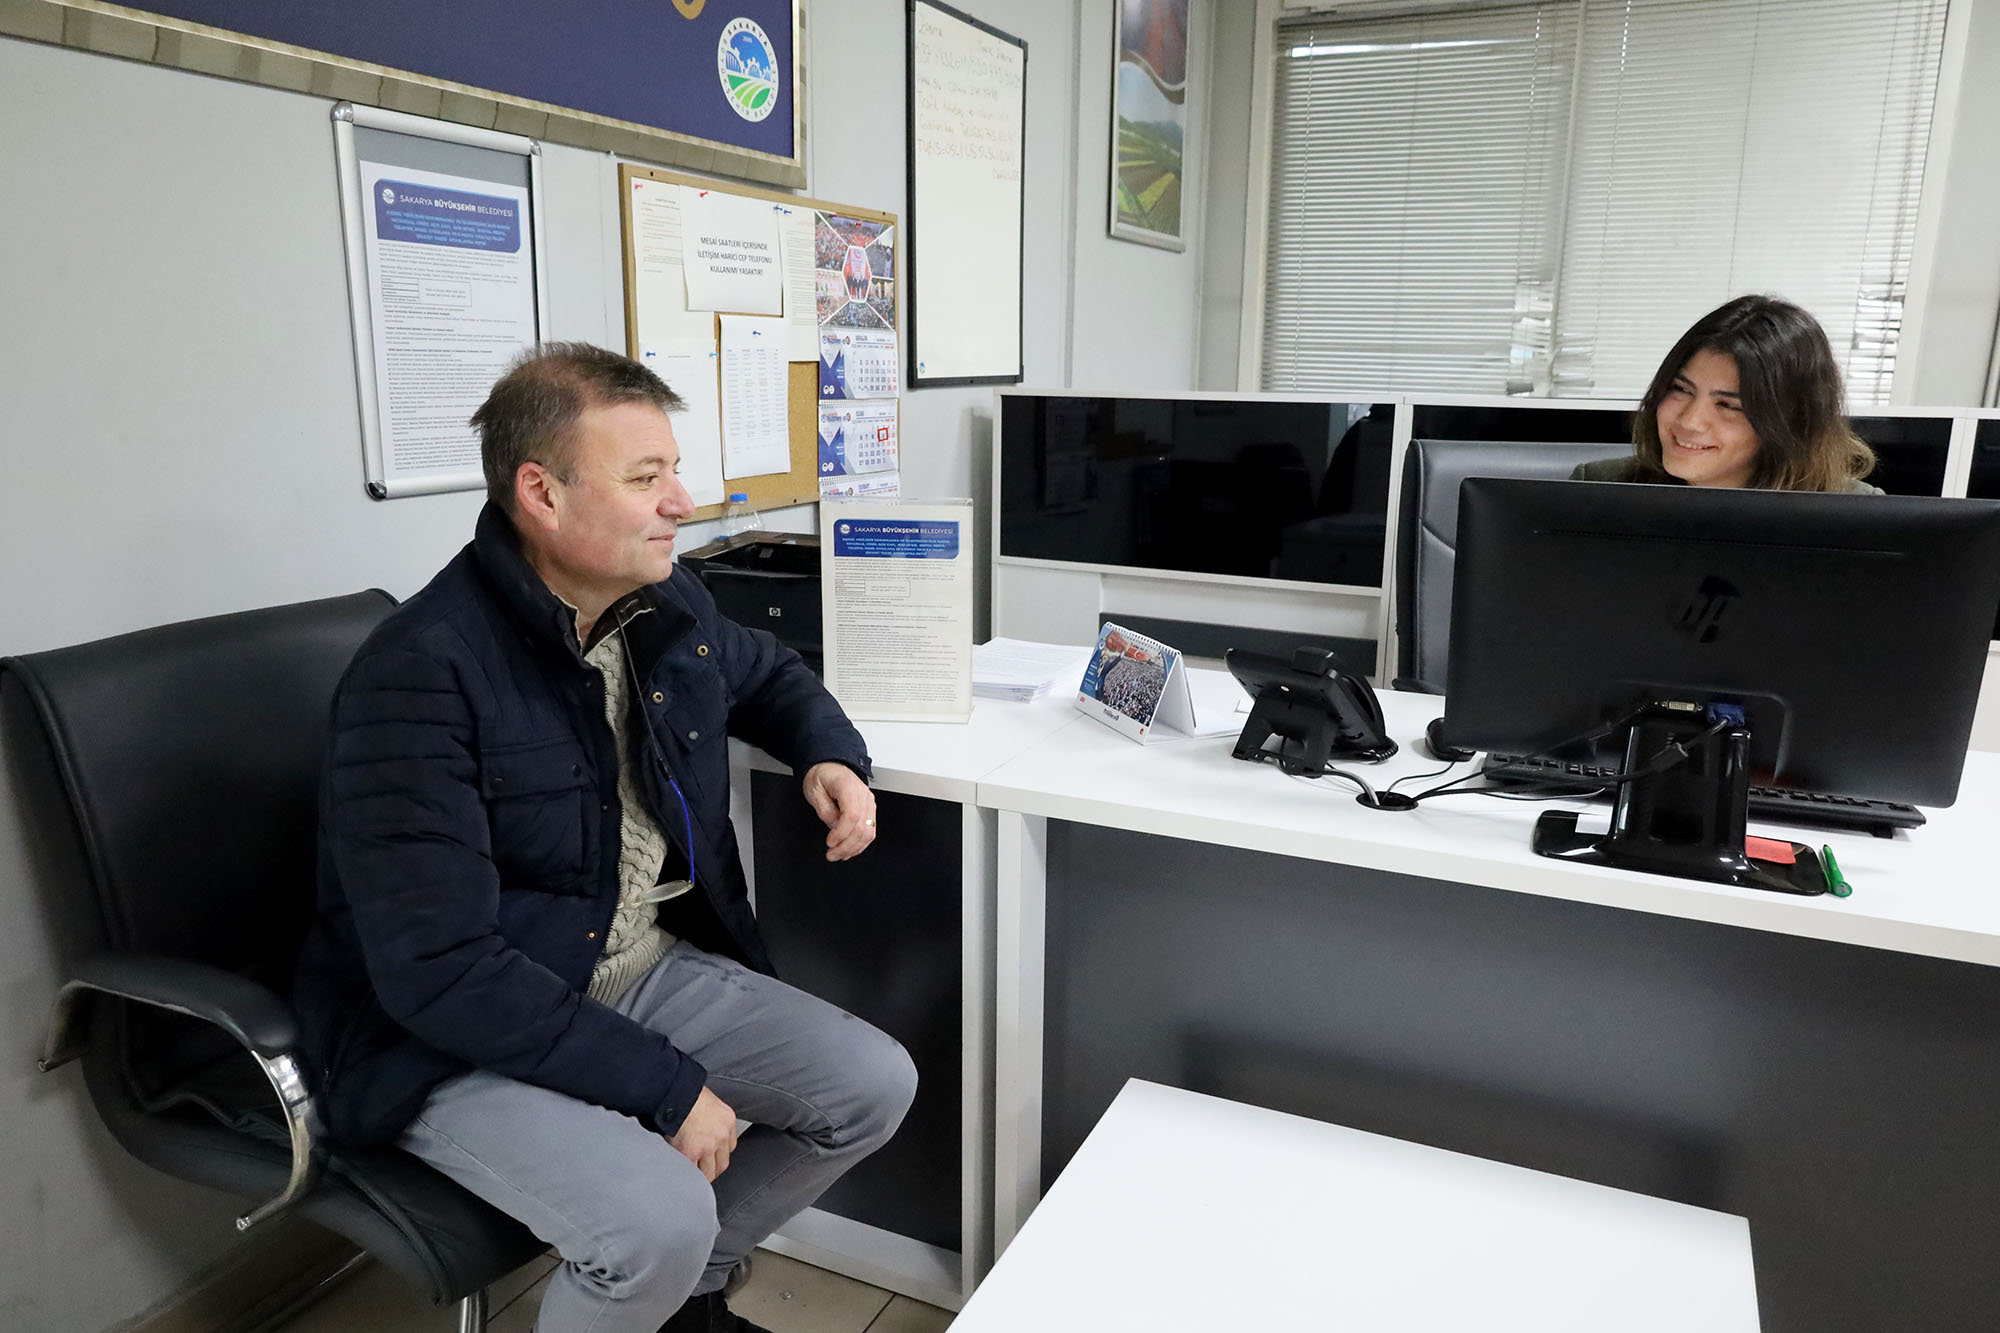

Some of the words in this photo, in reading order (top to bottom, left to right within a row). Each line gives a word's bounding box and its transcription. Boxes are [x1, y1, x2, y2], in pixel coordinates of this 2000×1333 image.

[728, 22, 768, 46] SAKARYA
[400, 195, 433, 206] SAKARYA
[434, 199, 477, 213] BÜYÜKŞEHİR
[477, 206, 513, 217] BELEDİYESİ
[700, 236, 718, 246] MESAİ
[718, 239, 742, 248] SAATLERİ
[742, 240, 768, 251] İÇERİSİNDE
[697, 250, 720, 261] İLETİŞİM
[738, 254, 747, 262] CEP
[748, 255, 773, 264] TELEFONU
[710, 266, 738, 275] KULLANIMI
[882, 526, 920, 535] BÜYÜKŞEHİR
[920, 527, 954, 535] BELEDİYESİ
